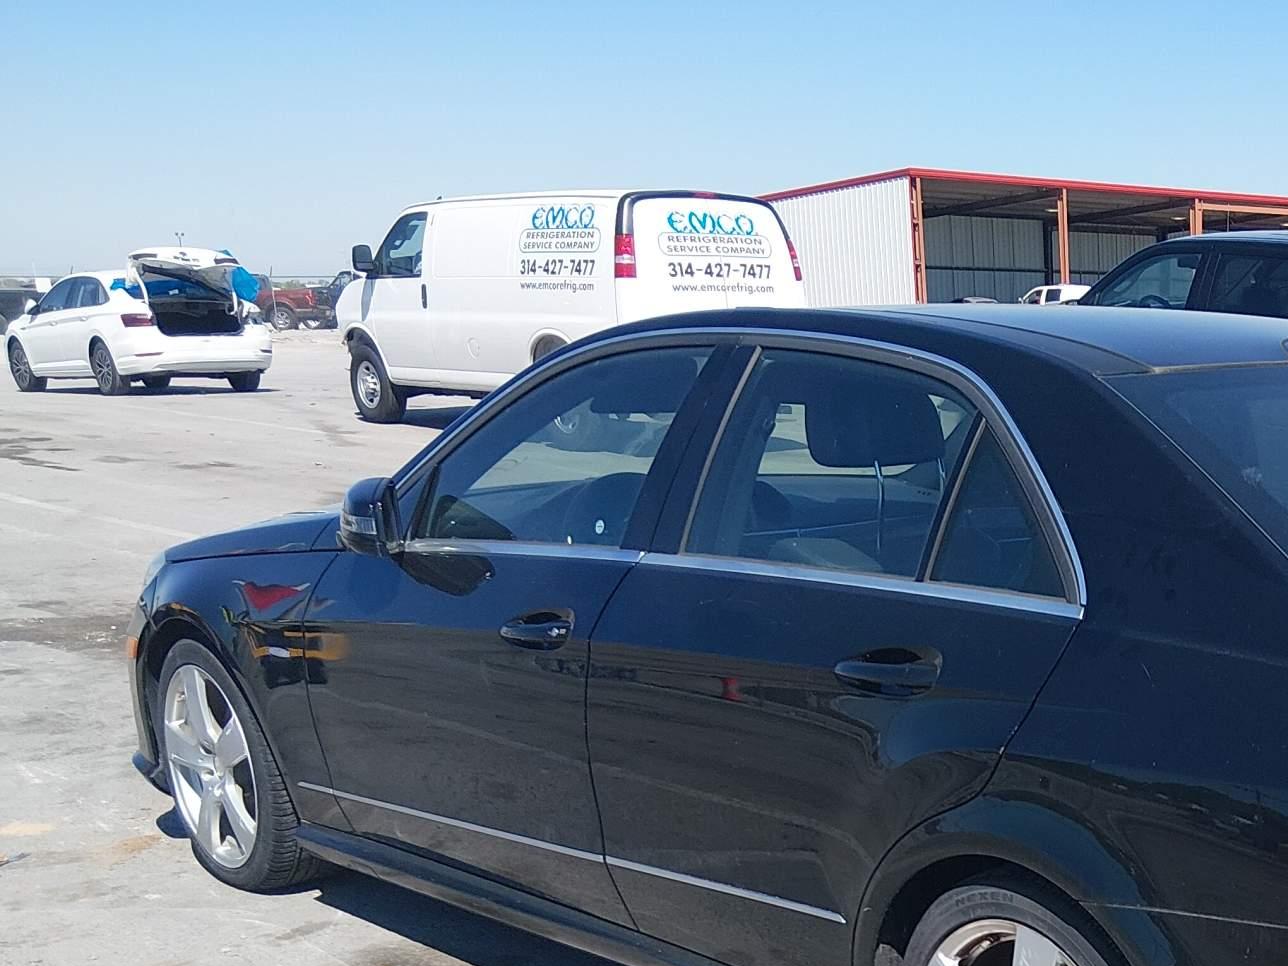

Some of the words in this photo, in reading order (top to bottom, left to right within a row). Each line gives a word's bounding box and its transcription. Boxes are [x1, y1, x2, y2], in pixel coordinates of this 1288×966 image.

[526, 231, 594, 240] REFRIGERATION
[667, 235, 763, 246] REFRIGERATION
[523, 241, 552, 250] SERVICE
[554, 241, 595, 250] COMPANY
[667, 245, 712, 253] SERVICE
[715, 246, 765, 255] COMPANY
[520, 259, 595, 275] 314-427-7477
[668, 262, 771, 279] 314-427-7477
[520, 280, 594, 293] www.emcorefrig.com
[672, 283, 774, 294] www.emcorefrig.com
